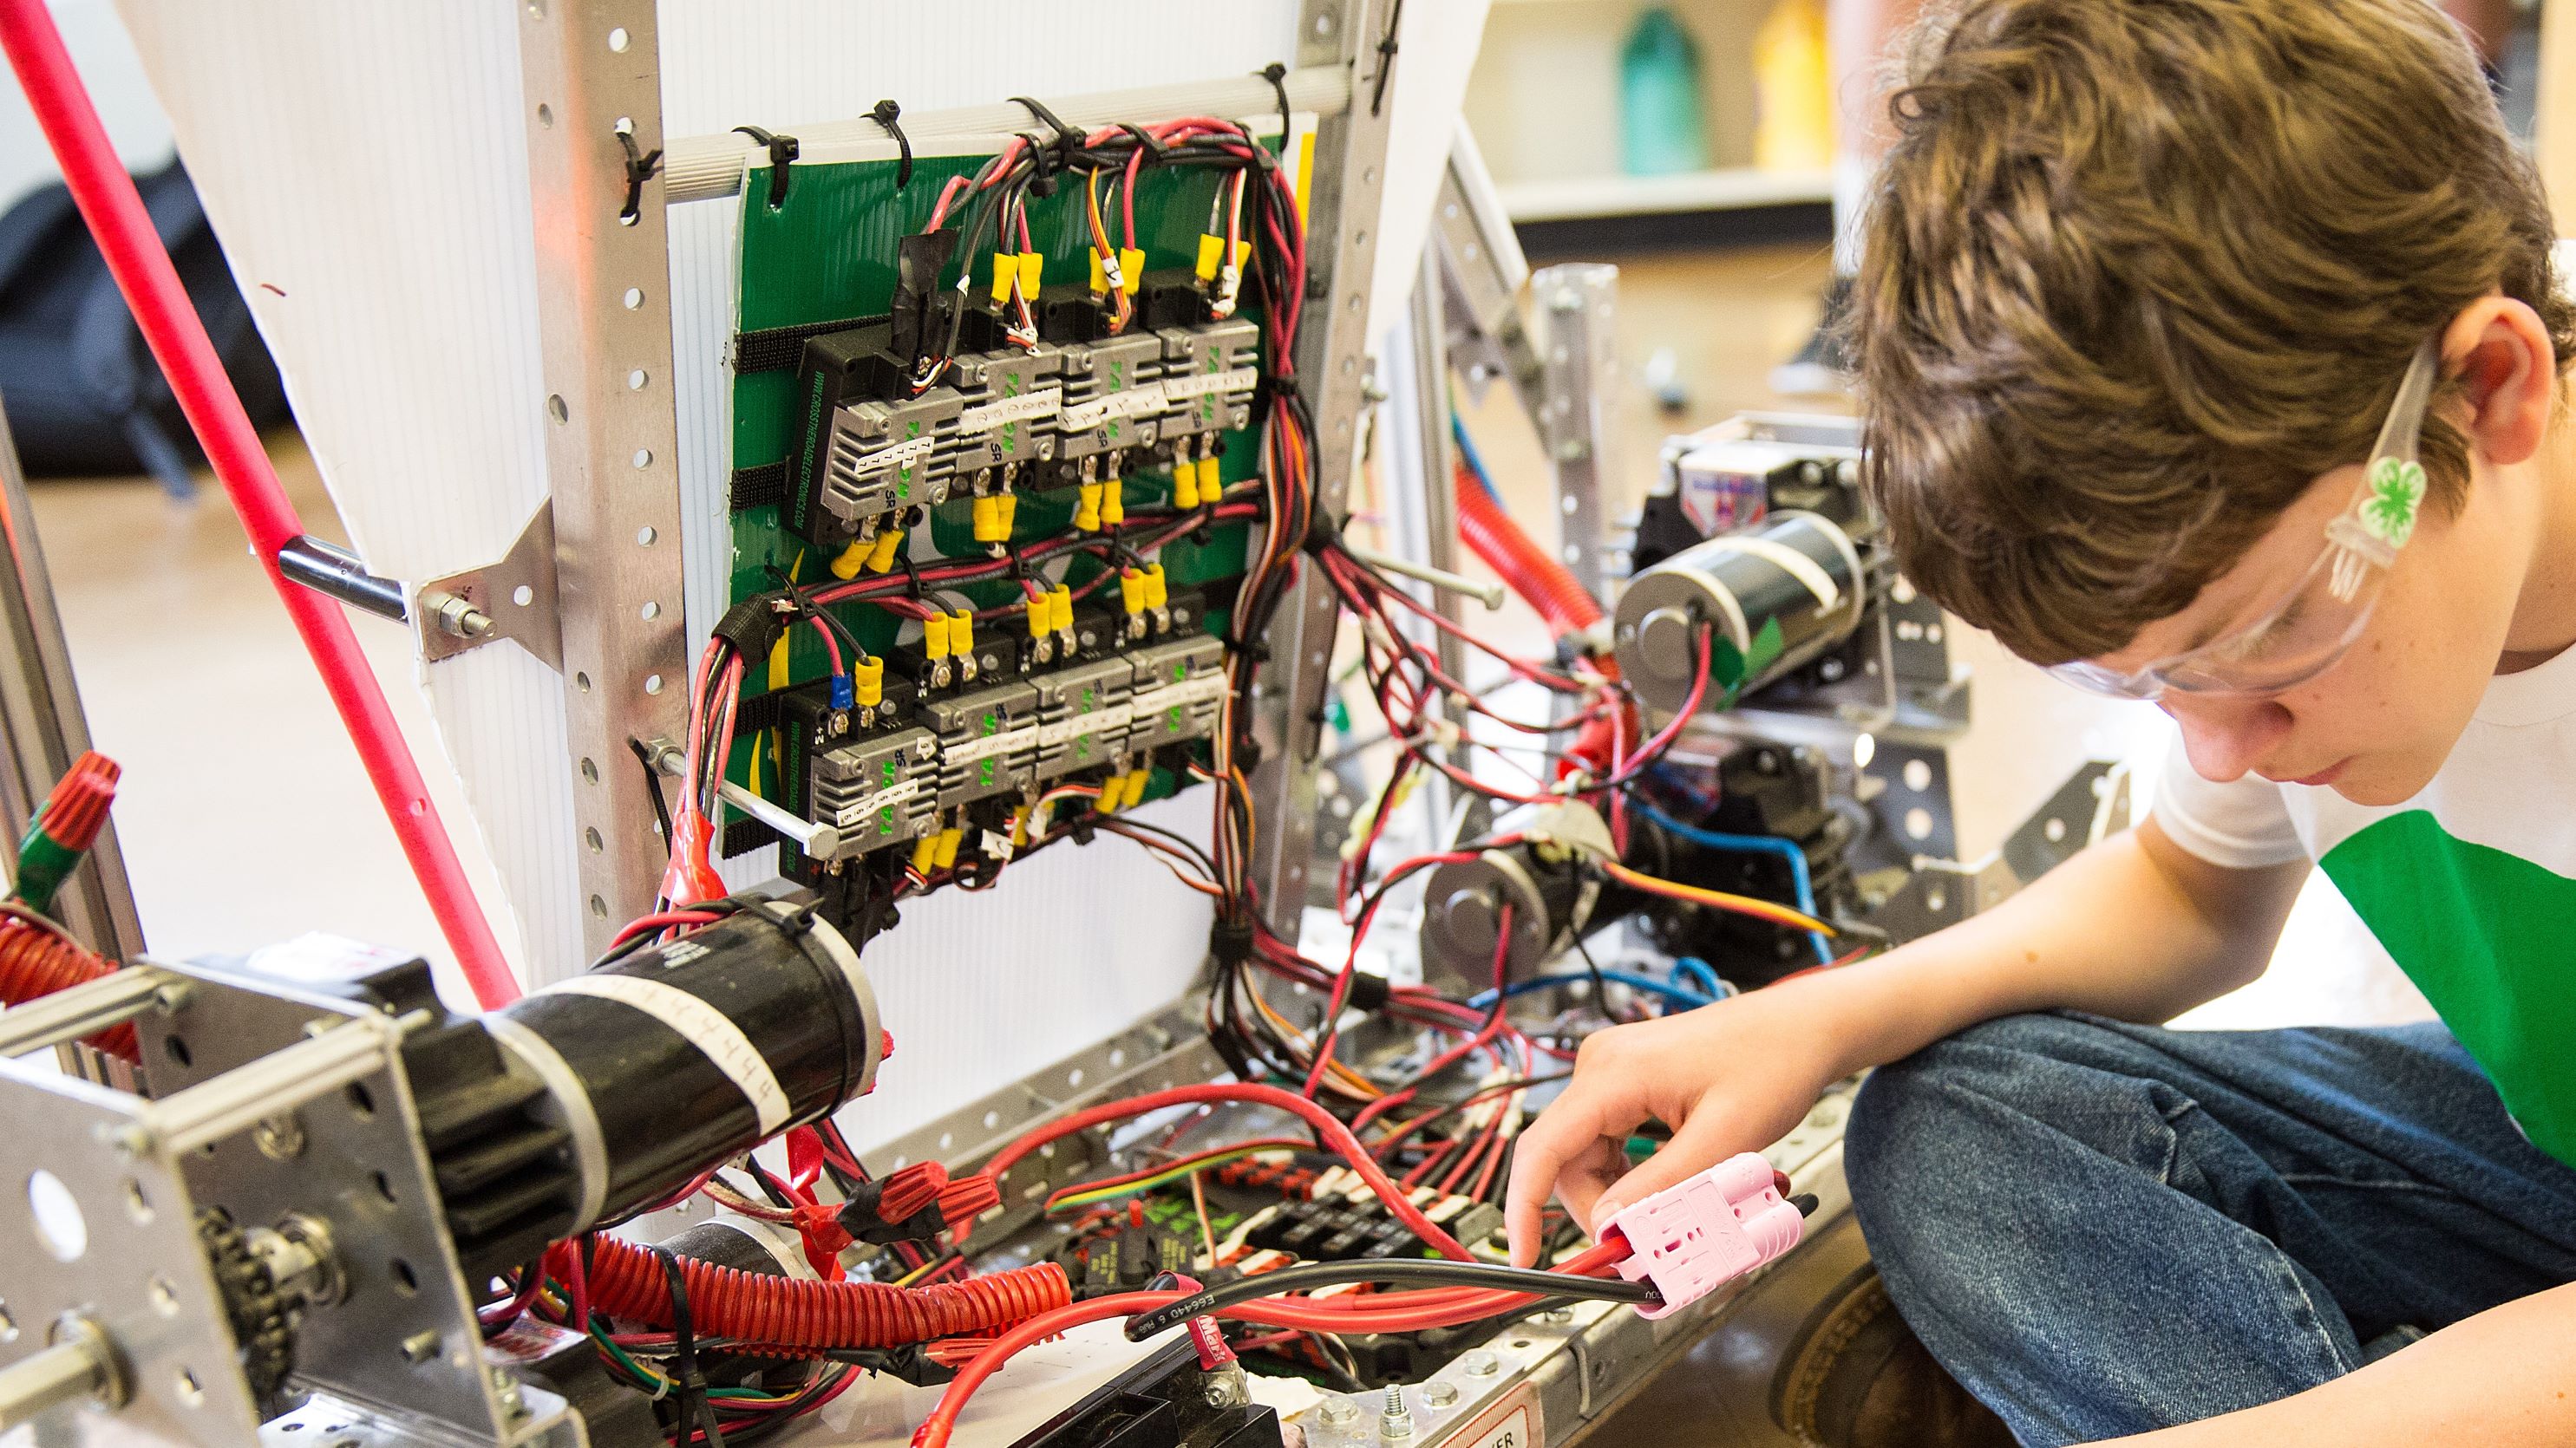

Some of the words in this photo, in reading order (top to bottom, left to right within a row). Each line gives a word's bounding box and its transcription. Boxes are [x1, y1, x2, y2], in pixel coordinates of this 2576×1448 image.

[990, 442, 1003, 462] SR
[885, 489, 896, 509] SR
[894, 748, 906, 767] SR
[1170, 1295, 1214, 1318] E66440
[1158, 1315, 1166, 1324] 6
